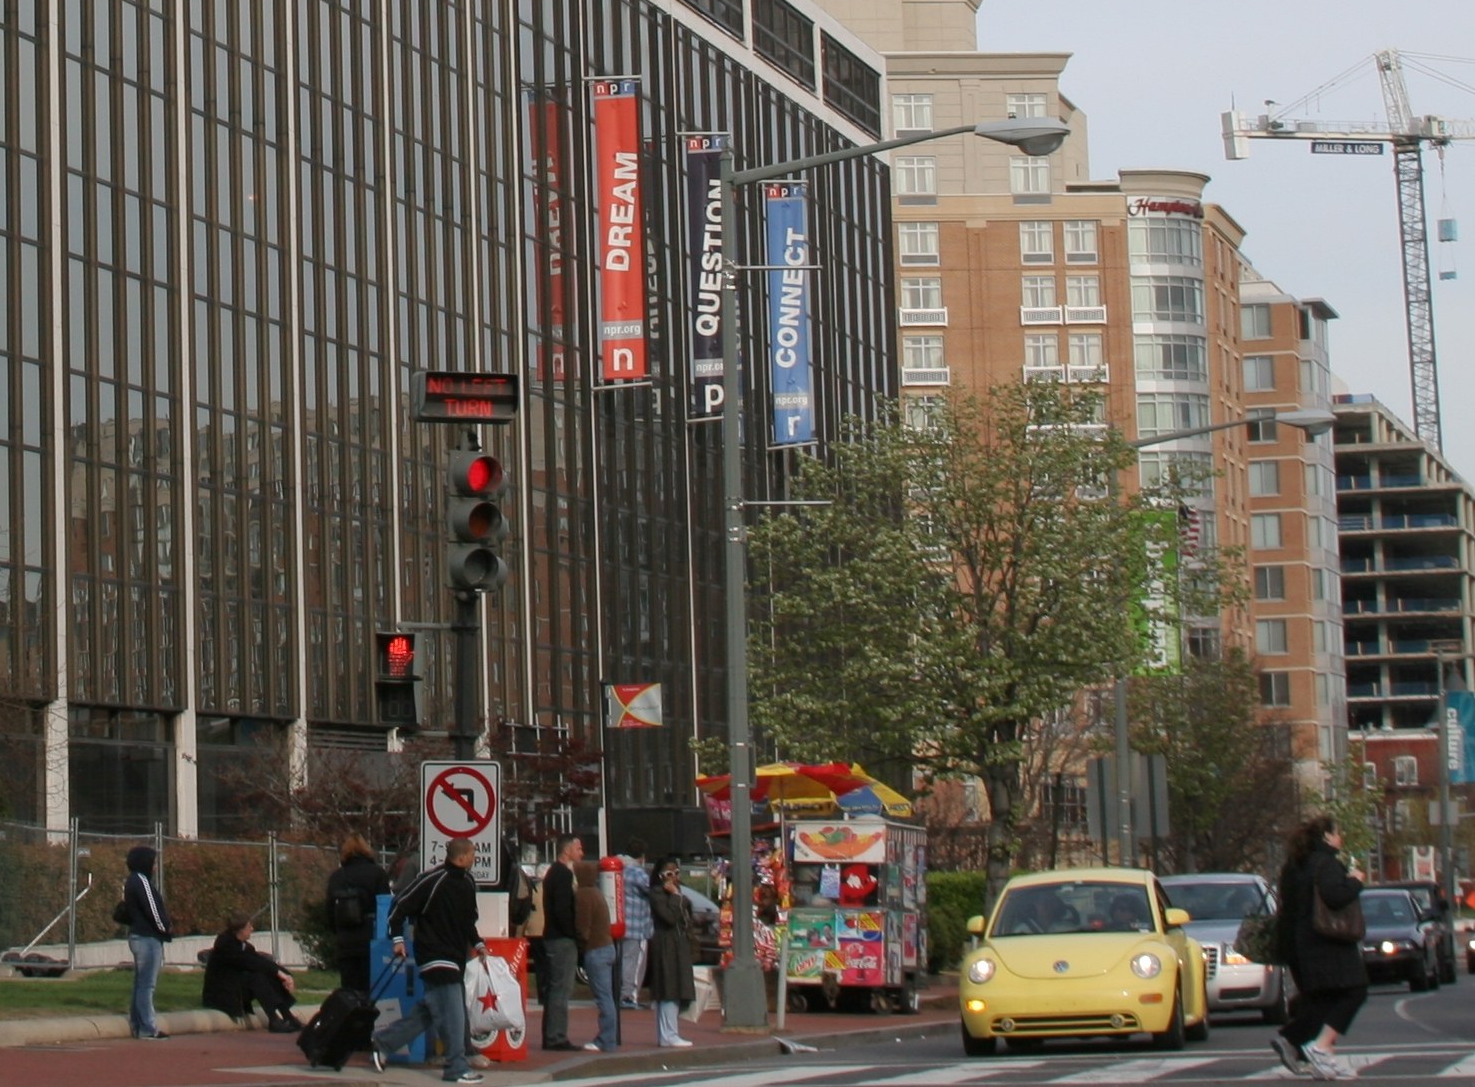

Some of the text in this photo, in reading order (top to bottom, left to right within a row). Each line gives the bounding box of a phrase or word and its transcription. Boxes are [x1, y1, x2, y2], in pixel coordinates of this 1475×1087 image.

[596, 82, 630, 95] npr
[690, 137, 720, 150] npr
[1314, 143, 1380, 154] MILLER & LONG
[769, 186, 799, 198] npr
[606, 152, 638, 272] DREAM
[696, 179, 723, 337] QUESTION
[775, 227, 807, 369] CONNECT
[604, 324, 642, 336] npr.org
[612, 347, 634, 372] n
[427, 377, 508, 395] NO LEFT
[444, 398, 494, 417] TURN
[704, 384, 725, 414] p
[787, 415, 801, 436] r
[1447, 707, 1463, 770] culture
[475, 842, 491, 853] AM
[474, 856, 492, 868] PM
